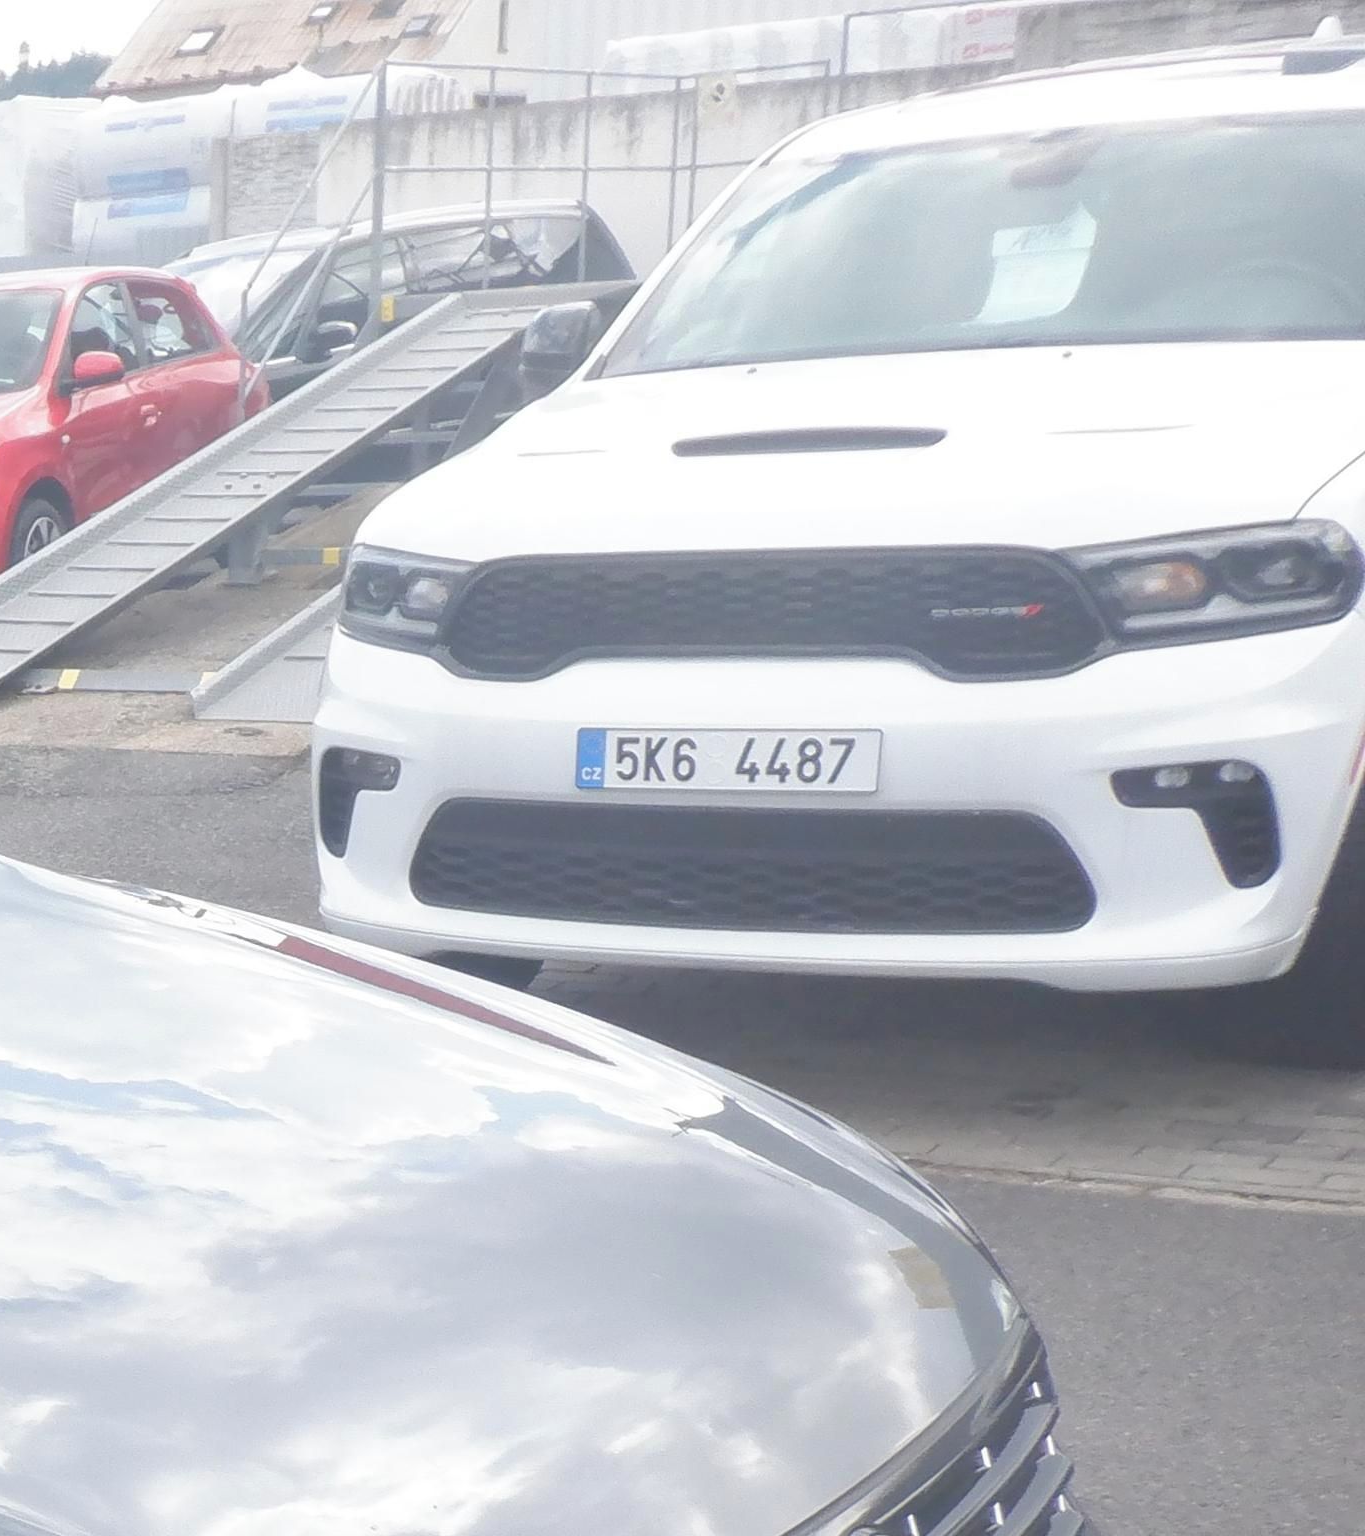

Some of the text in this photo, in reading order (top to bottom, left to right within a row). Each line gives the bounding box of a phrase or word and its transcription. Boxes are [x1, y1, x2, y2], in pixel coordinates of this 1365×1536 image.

[580, 768, 602, 782] CZ
[615, 736, 856, 785] 5K6 4487
